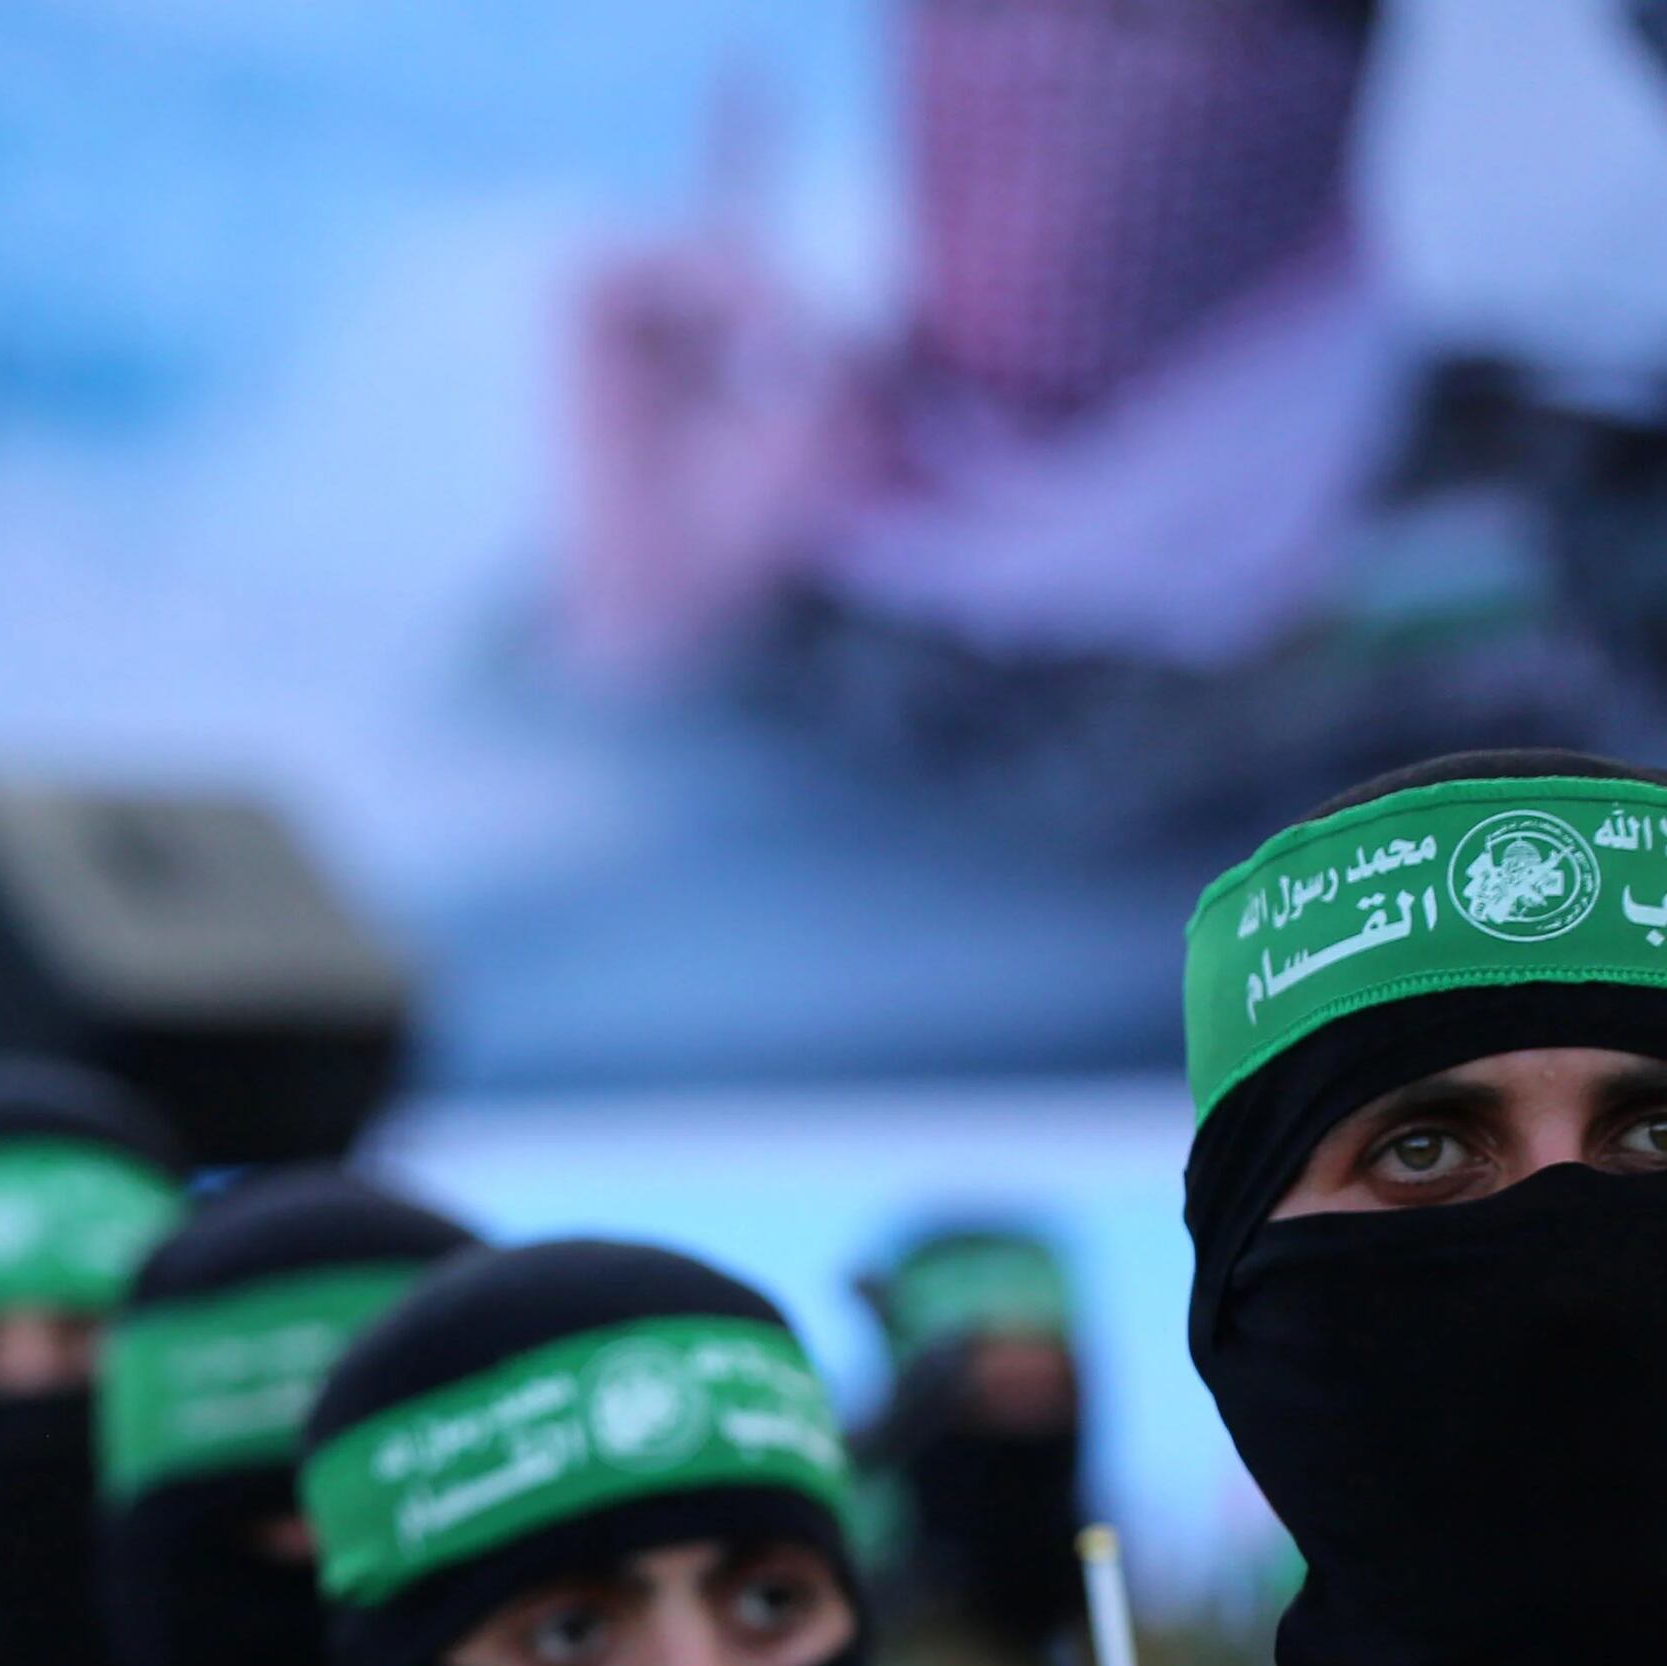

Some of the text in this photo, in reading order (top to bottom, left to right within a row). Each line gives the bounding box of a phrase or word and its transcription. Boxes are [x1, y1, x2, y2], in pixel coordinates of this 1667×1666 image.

[1593, 801, 1653, 851] الله
[1345, 834, 1437, 883] محمد
[1236, 887, 1269, 940] الله
[1271, 866, 1339, 929] رسول
[1245, 885, 1438, 1027] القسام
